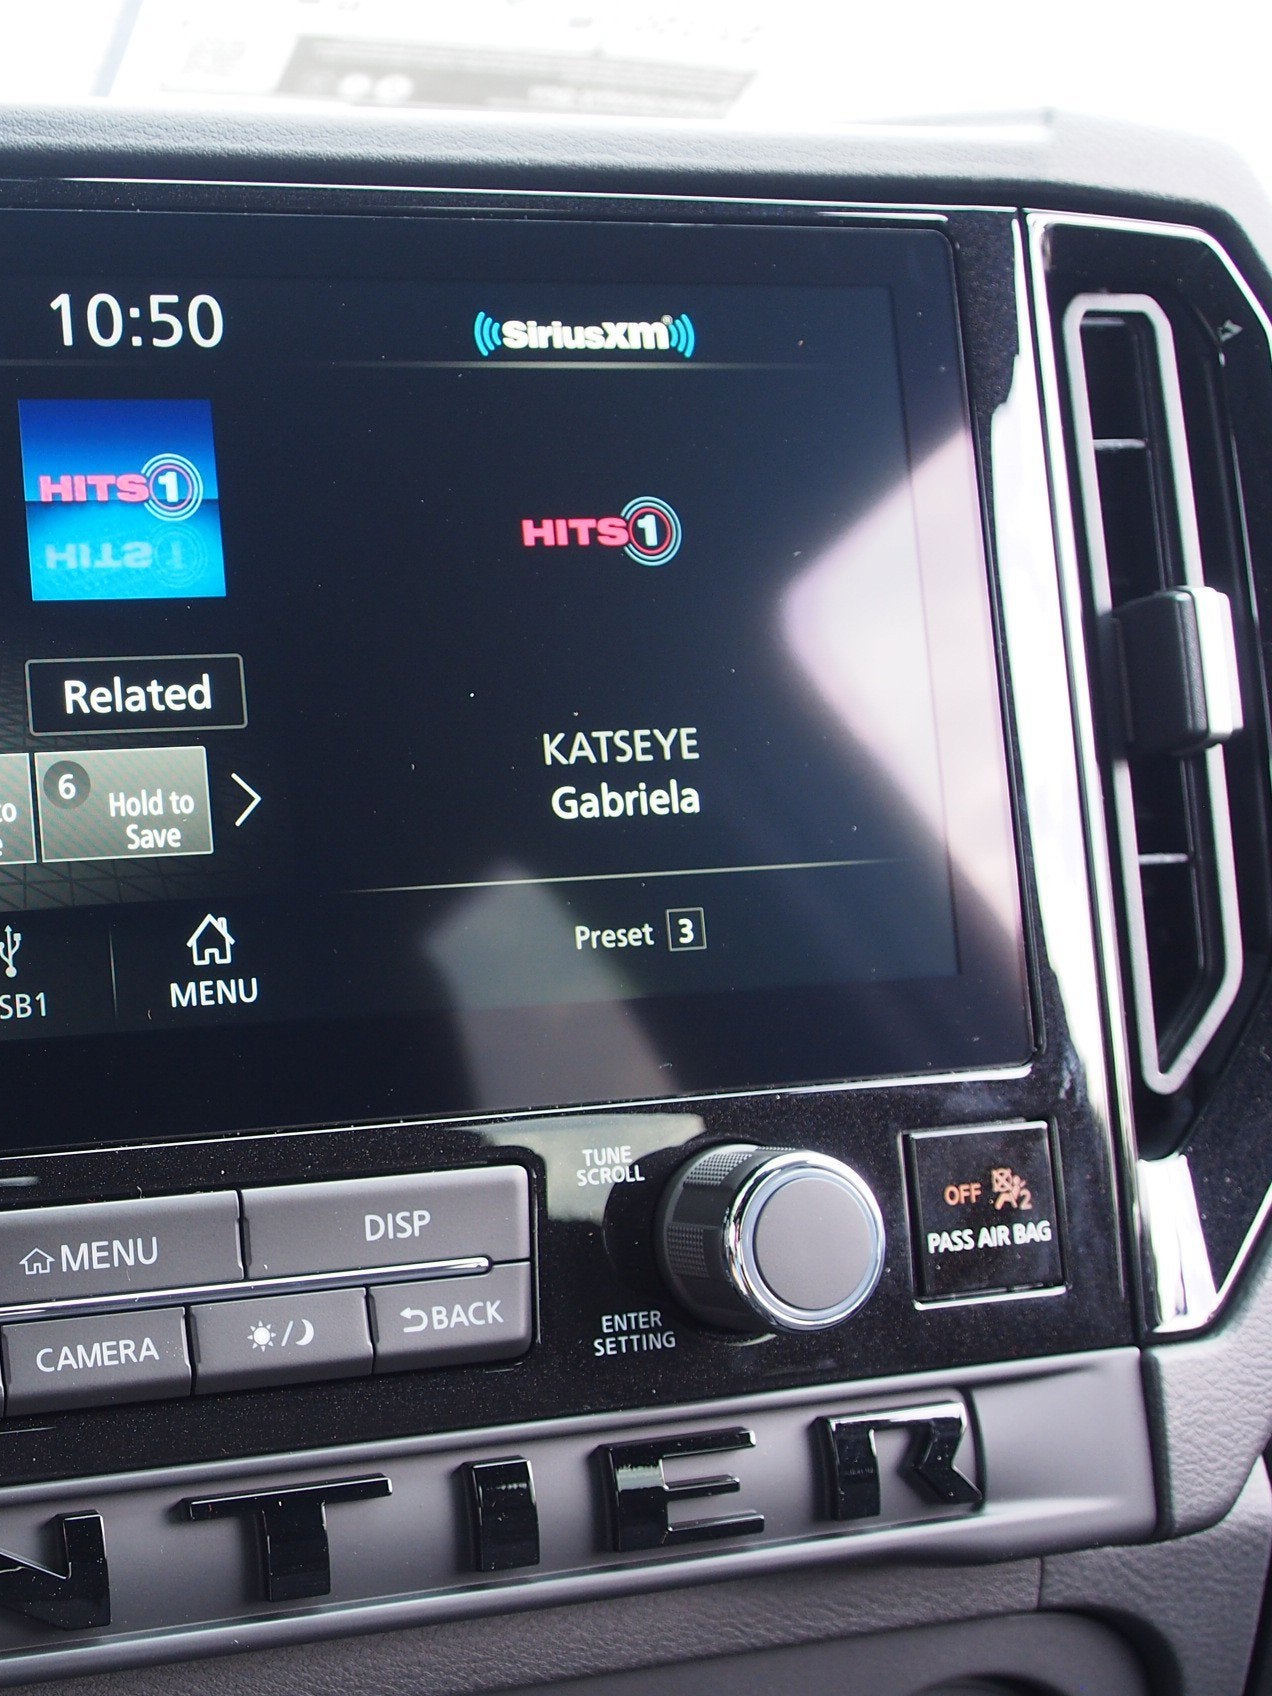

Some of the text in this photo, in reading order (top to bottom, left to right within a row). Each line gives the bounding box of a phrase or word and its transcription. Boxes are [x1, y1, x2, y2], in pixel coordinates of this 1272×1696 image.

[49, 292, 225, 349] 10:50
[39, 472, 180, 503] HITS 1
[521, 514, 658, 547] HITS 1
[63, 673, 213, 715] Related
[543, 727, 701, 766] KATSEYE
[57, 774, 77, 800] 6
[551, 778, 702, 820] Gabriela
[108, 789, 195, 817] Hold to
[125, 823, 182, 850] Save
[574, 918, 694, 950] Preset 3
[169, 977, 259, 1008] MENU
[582, 1145, 632, 1167] TUNE
[576, 1164, 645, 1187] SCROLL
[944, 1182, 982, 1206] OFF
[364, 1209, 431, 1242] DISP
[927, 1220, 1052, 1255] PASS AIR BAG
[59, 1236, 160, 1272] MENU
[431, 1300, 504, 1331] BACK
[601, 1309, 662, 1334] ENTER
[36, 1337, 160, 1373] CAMERA
[593, 1329, 677, 1357] SETTING
